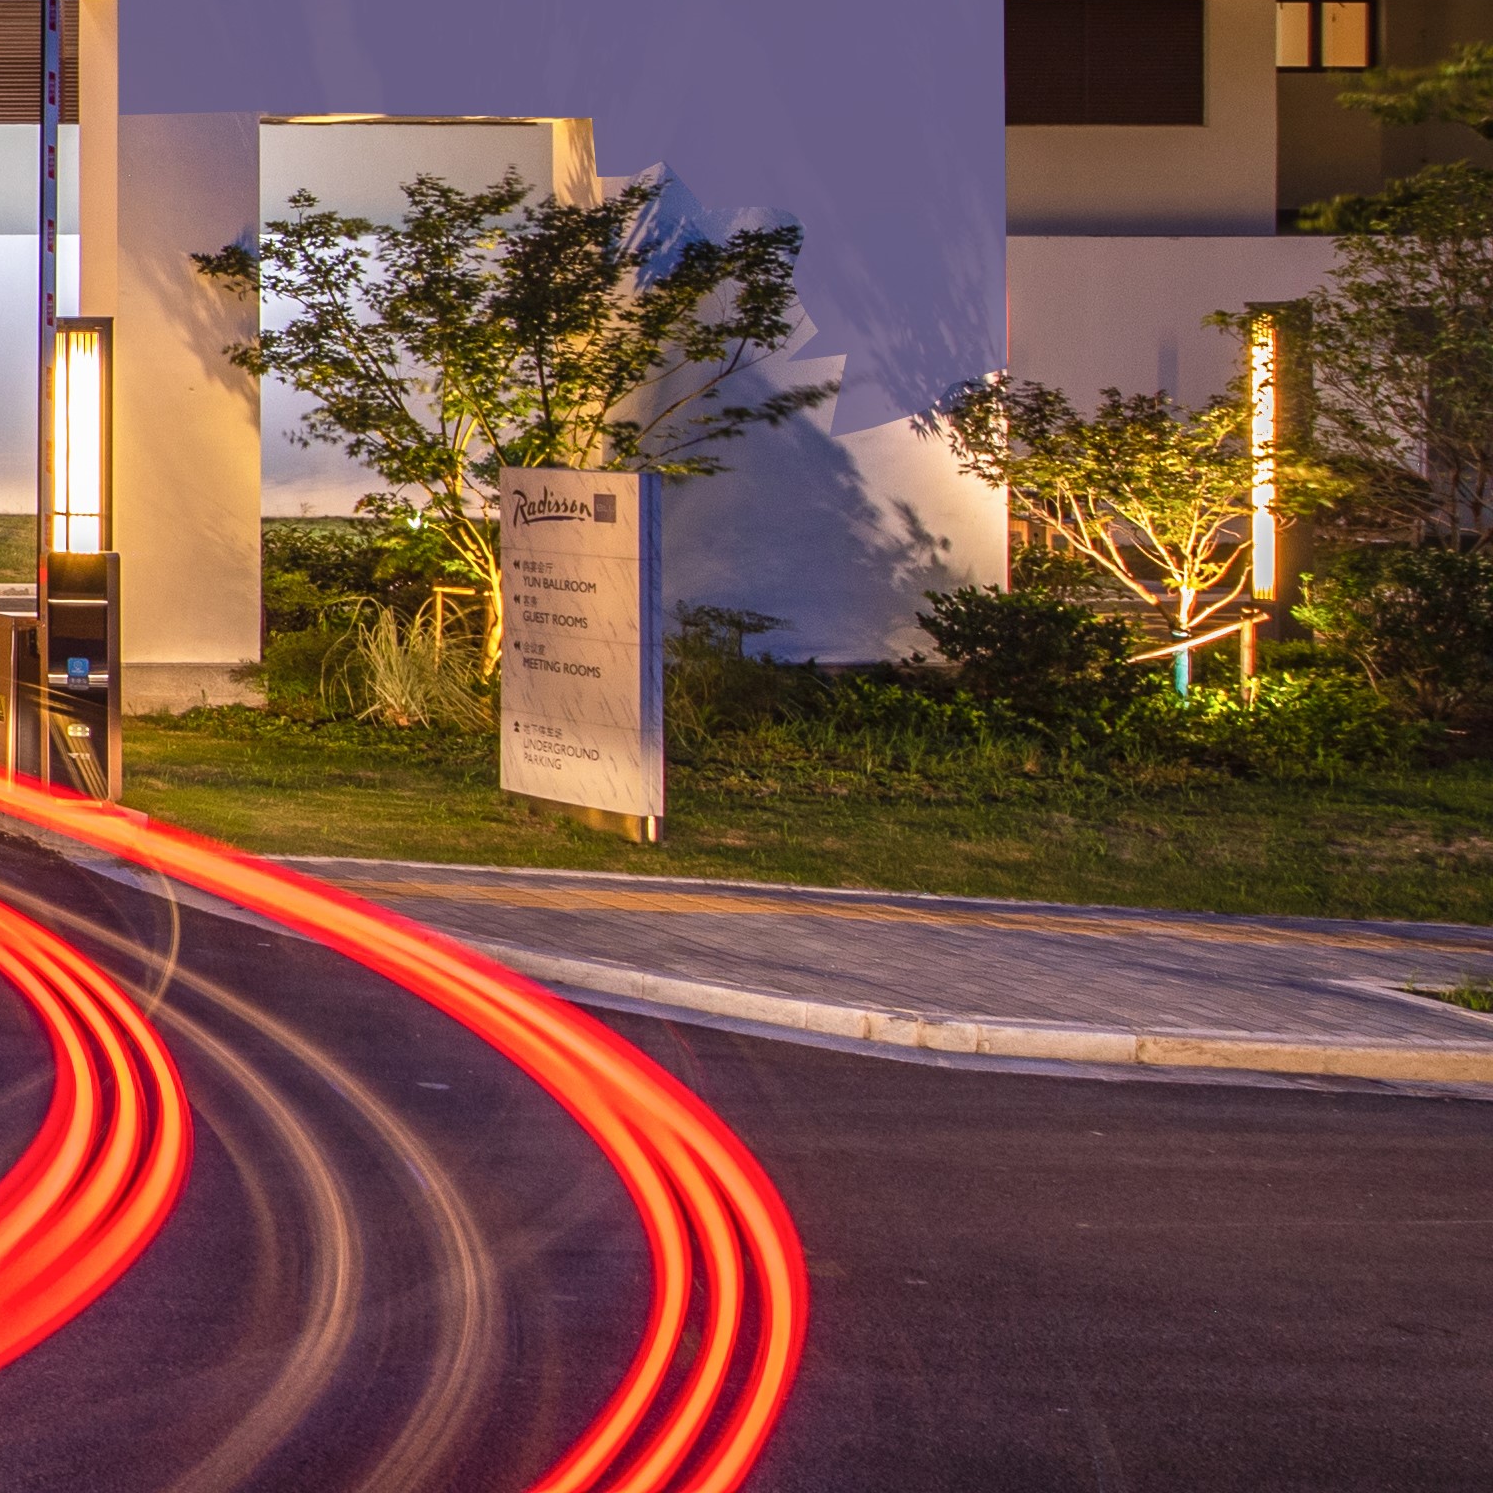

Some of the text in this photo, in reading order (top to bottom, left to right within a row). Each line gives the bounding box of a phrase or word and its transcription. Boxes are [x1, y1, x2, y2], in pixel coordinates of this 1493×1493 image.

[513, 485, 592, 528] Radisson
[523, 576, 597, 593] YUN BALLROOM
[523, 610, 588, 629] GUEST ROOMS
[523, 656, 601, 678] MEETING ROOMS
[523, 738, 600, 761] UNDERGROUND
[524, 752, 562, 770] PARKING
